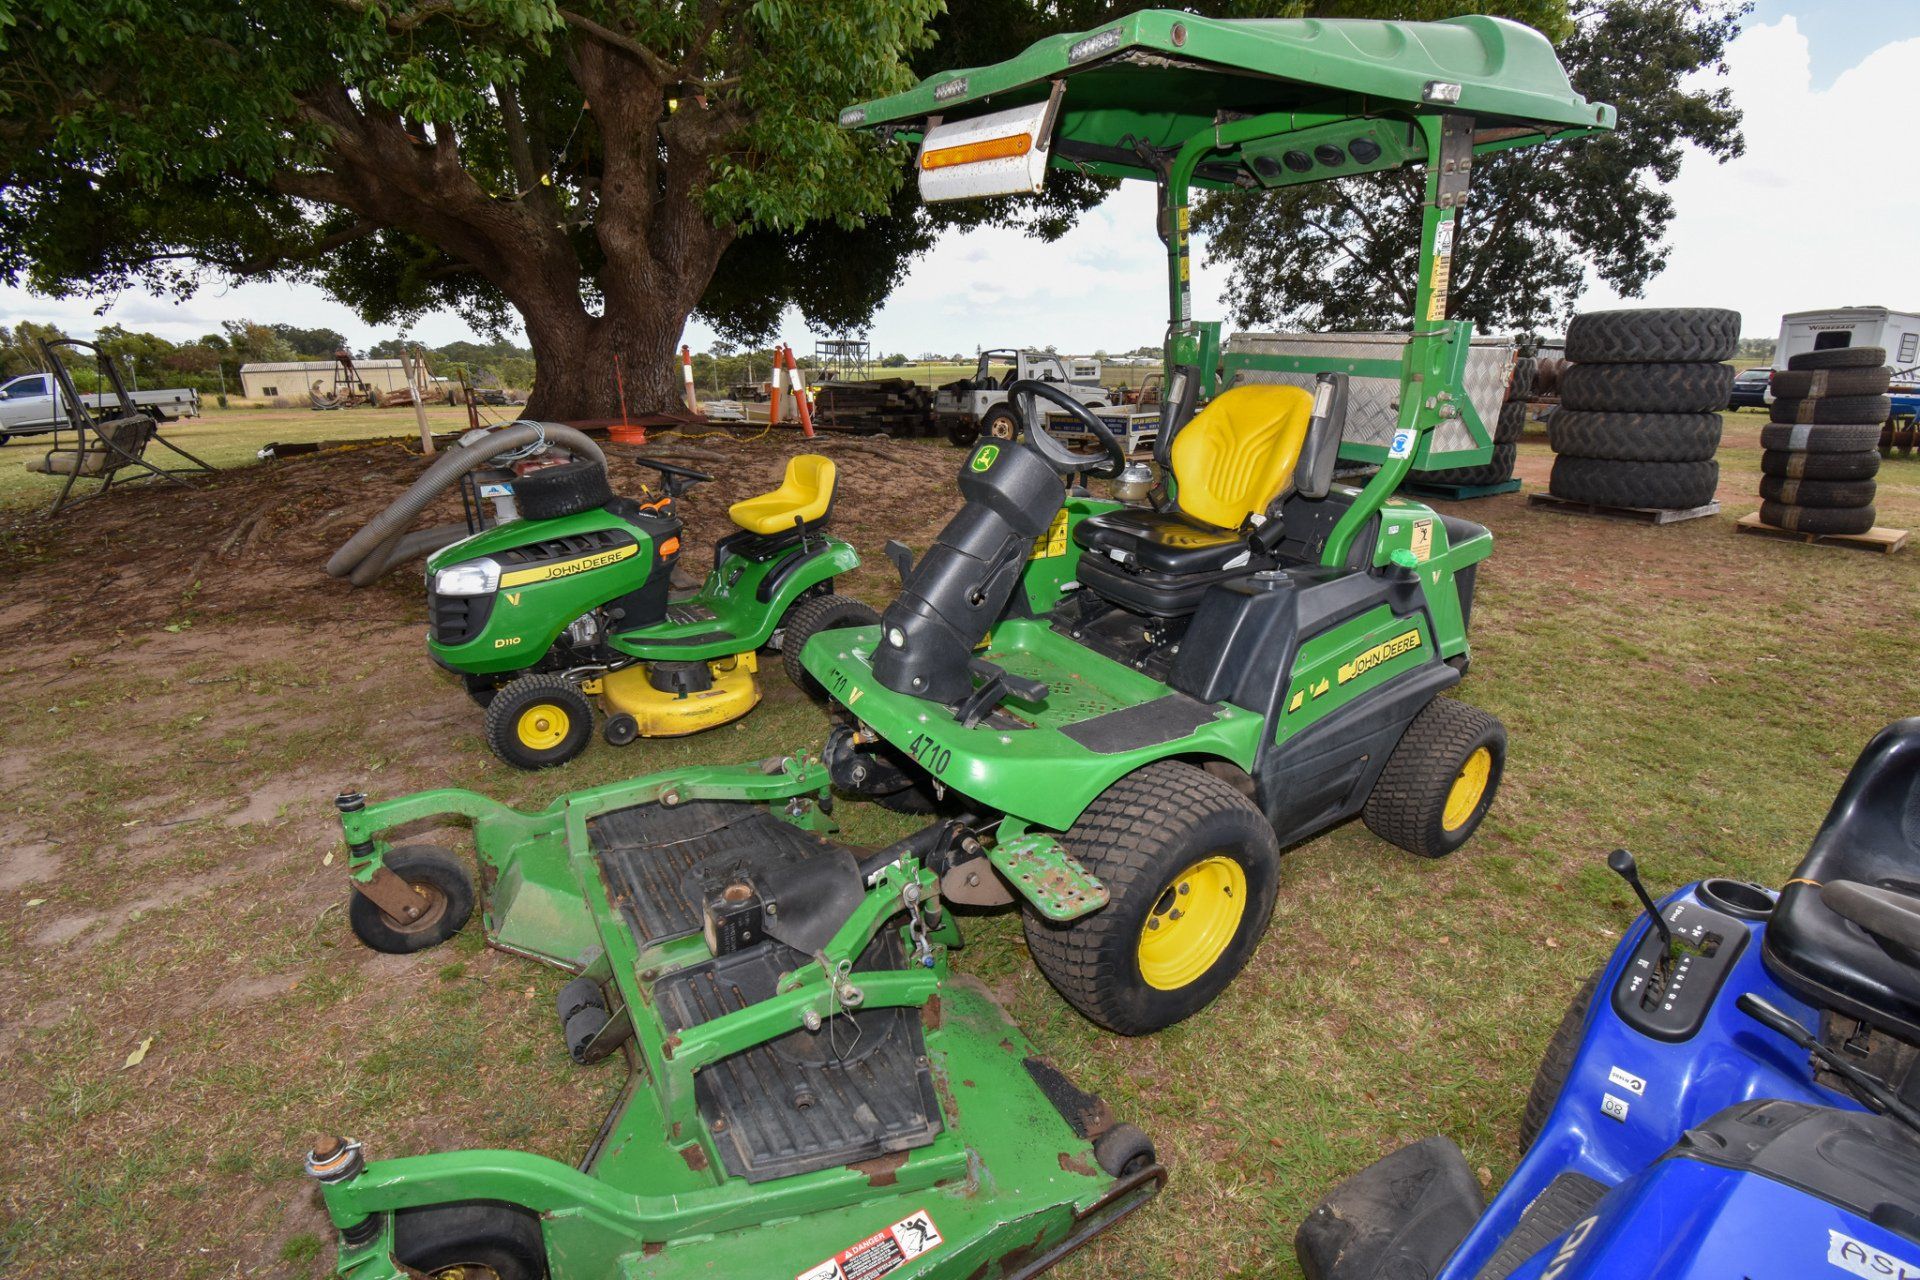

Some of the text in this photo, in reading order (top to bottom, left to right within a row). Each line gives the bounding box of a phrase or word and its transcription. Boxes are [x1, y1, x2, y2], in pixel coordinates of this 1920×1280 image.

[545, 552, 623, 579] JOHN DEERE
[1352, 635, 1416, 677] JOHN DEERE
[909, 733, 952, 775] 4710
[1606, 1100, 1623, 1115] 80
[852, 1232, 885, 1253] DANGER
